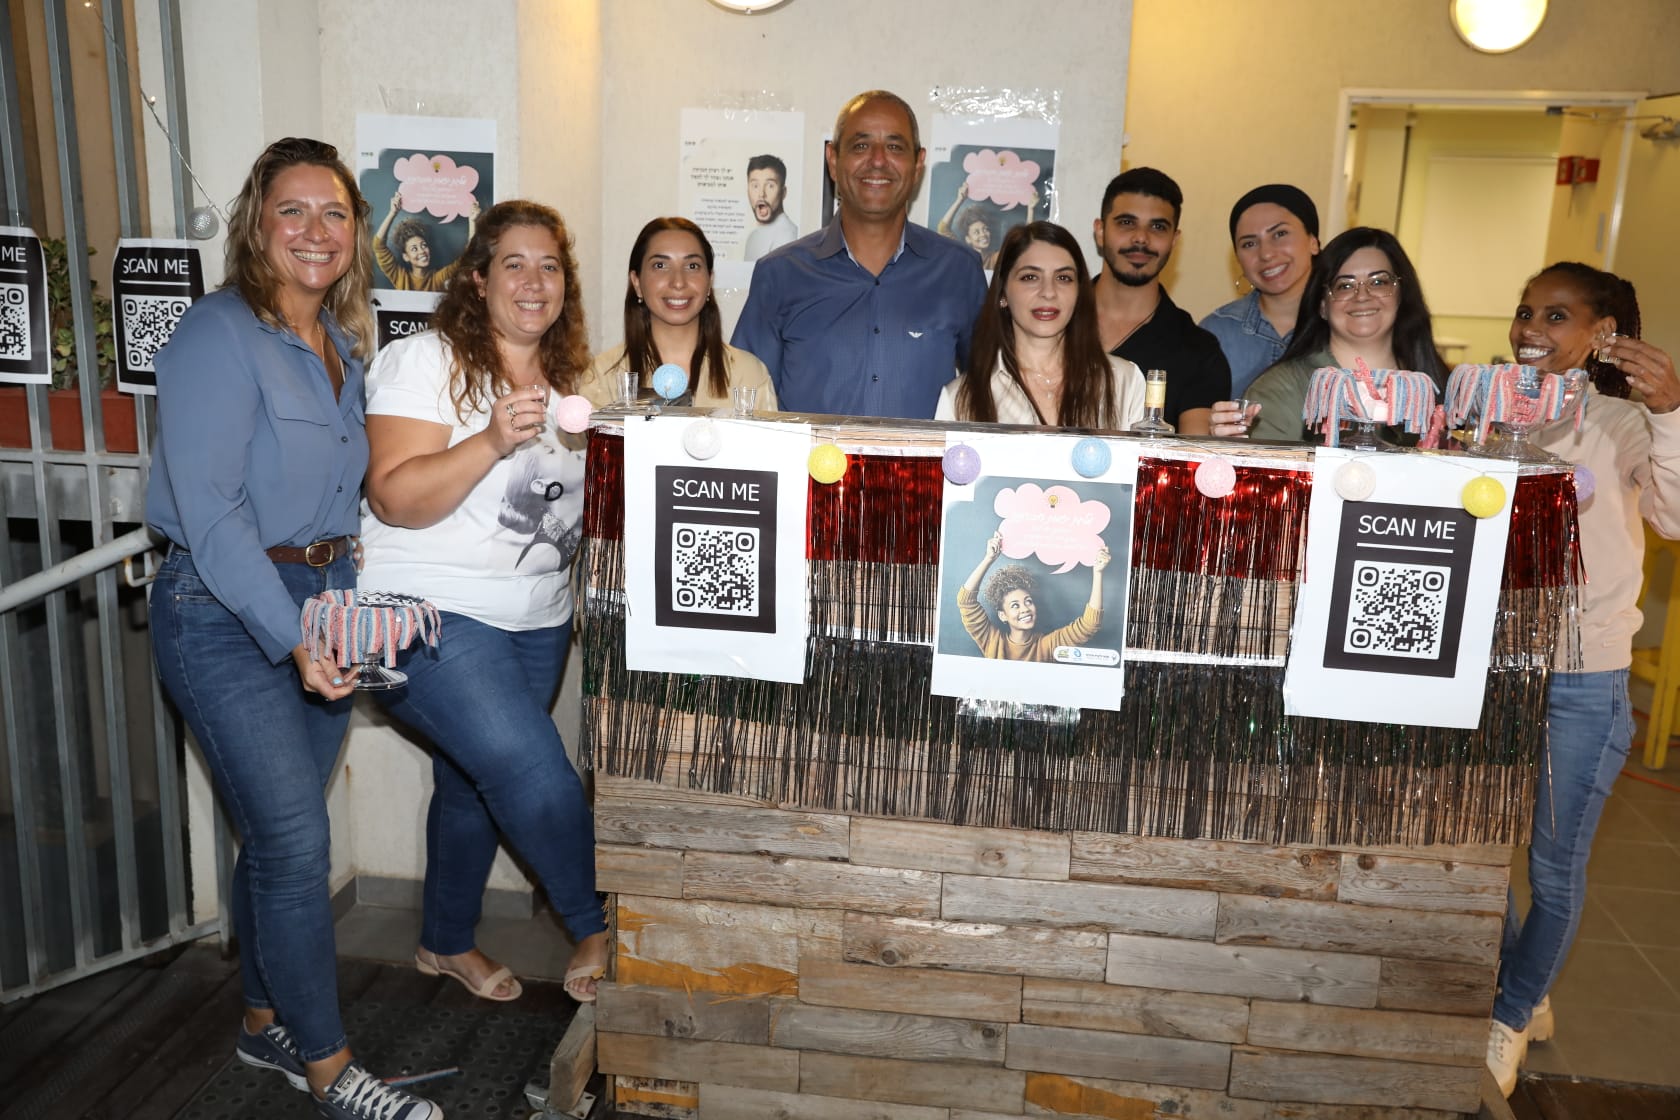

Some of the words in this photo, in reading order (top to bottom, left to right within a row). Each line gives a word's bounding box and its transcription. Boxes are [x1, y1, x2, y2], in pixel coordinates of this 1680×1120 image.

[1, 246, 27, 263] ME
[122, 257, 158, 274] SCAN
[164, 258, 190, 275] ME
[389, 320, 428, 335] SCAN
[672, 479, 724, 499] SCAN
[731, 483, 760, 502] ME
[1358, 515, 1416, 537] SCAN
[1423, 520, 1457, 540] ME
